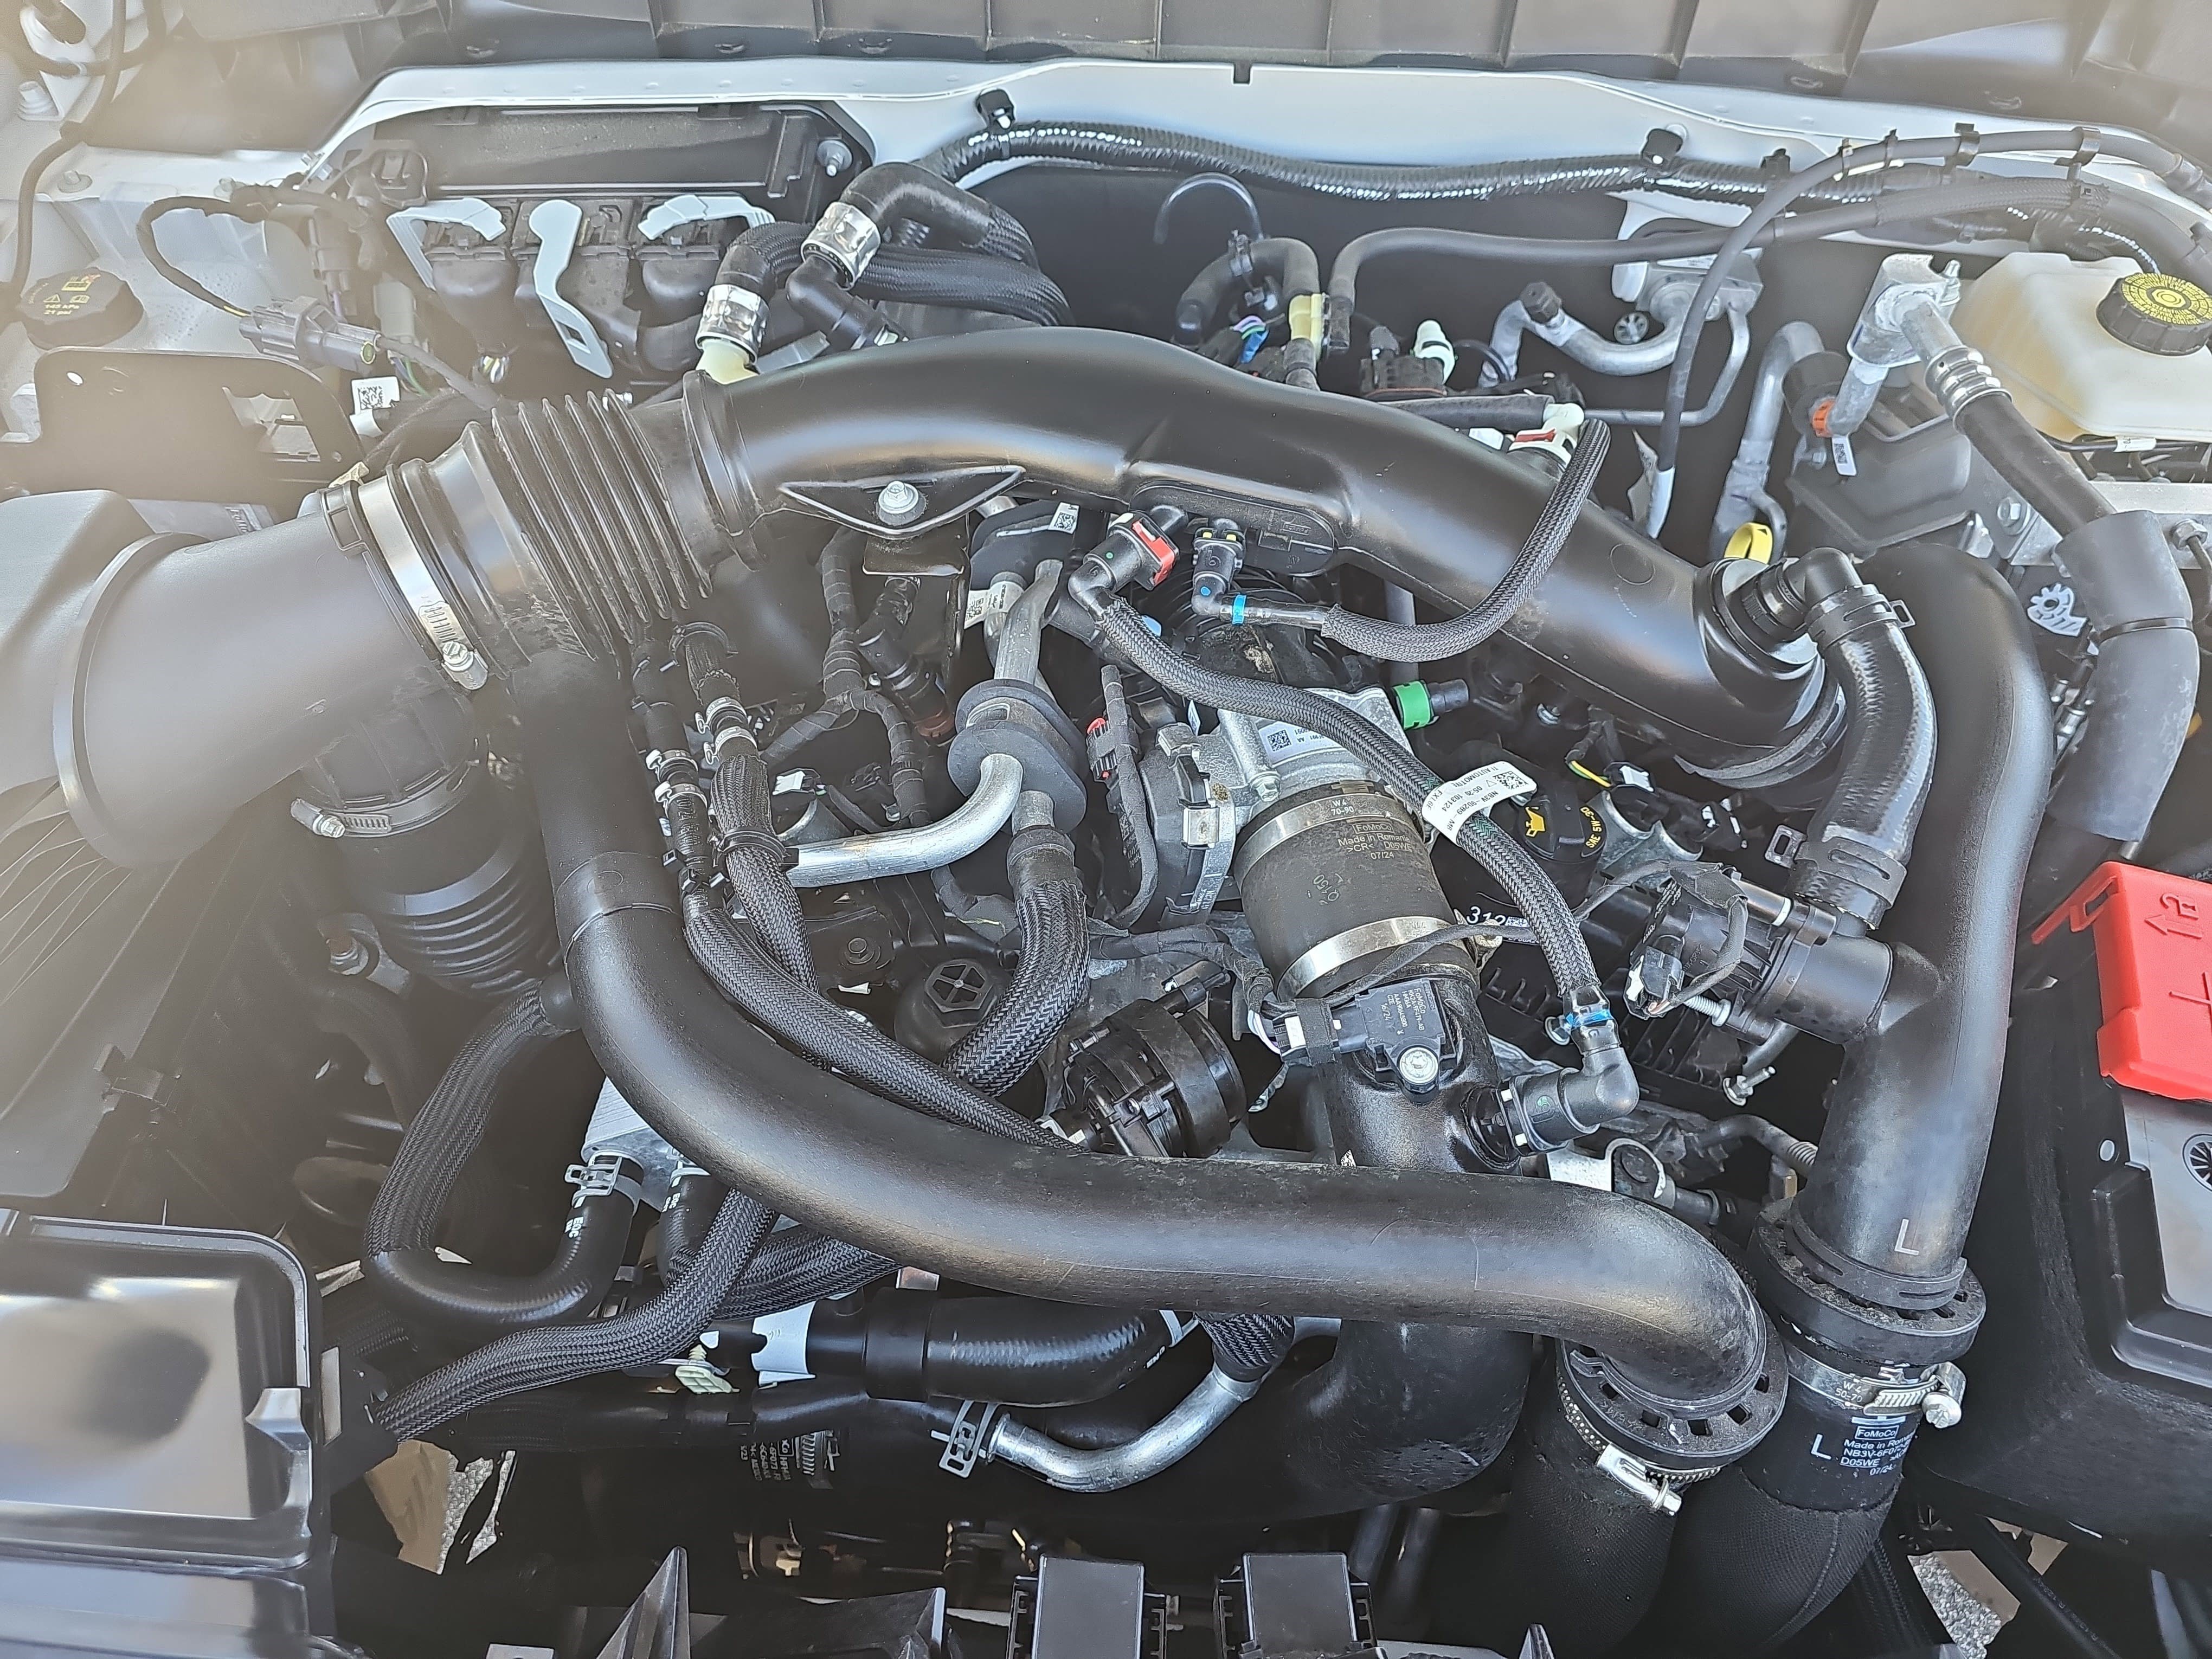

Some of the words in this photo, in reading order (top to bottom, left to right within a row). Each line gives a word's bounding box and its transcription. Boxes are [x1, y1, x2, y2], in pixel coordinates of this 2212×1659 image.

[1453, 768, 1491, 788] AUTOMOTIVE
[1330, 806, 1354, 815] 70-90
[1580, 807, 1602, 832] 5W-30
[1356, 824, 1392, 832] FoMoCo
[1338, 835, 1365, 846] Made
[1377, 833, 1411, 843] Romania
[1585, 834, 1601, 848] SAE
[1371, 851, 1394, 859] 07/24
[1414, 988, 1426, 1014] FoMoCo
[1894, 1218, 1919, 1256] L
[1834, 1387, 1863, 1403] 50-70
[1857, 1429, 1896, 1437] FoMoCo
[1810, 1433, 1831, 1460] L
[1844, 1439, 1875, 1449] Made
[1841, 1456, 1881, 1467] D05WE
